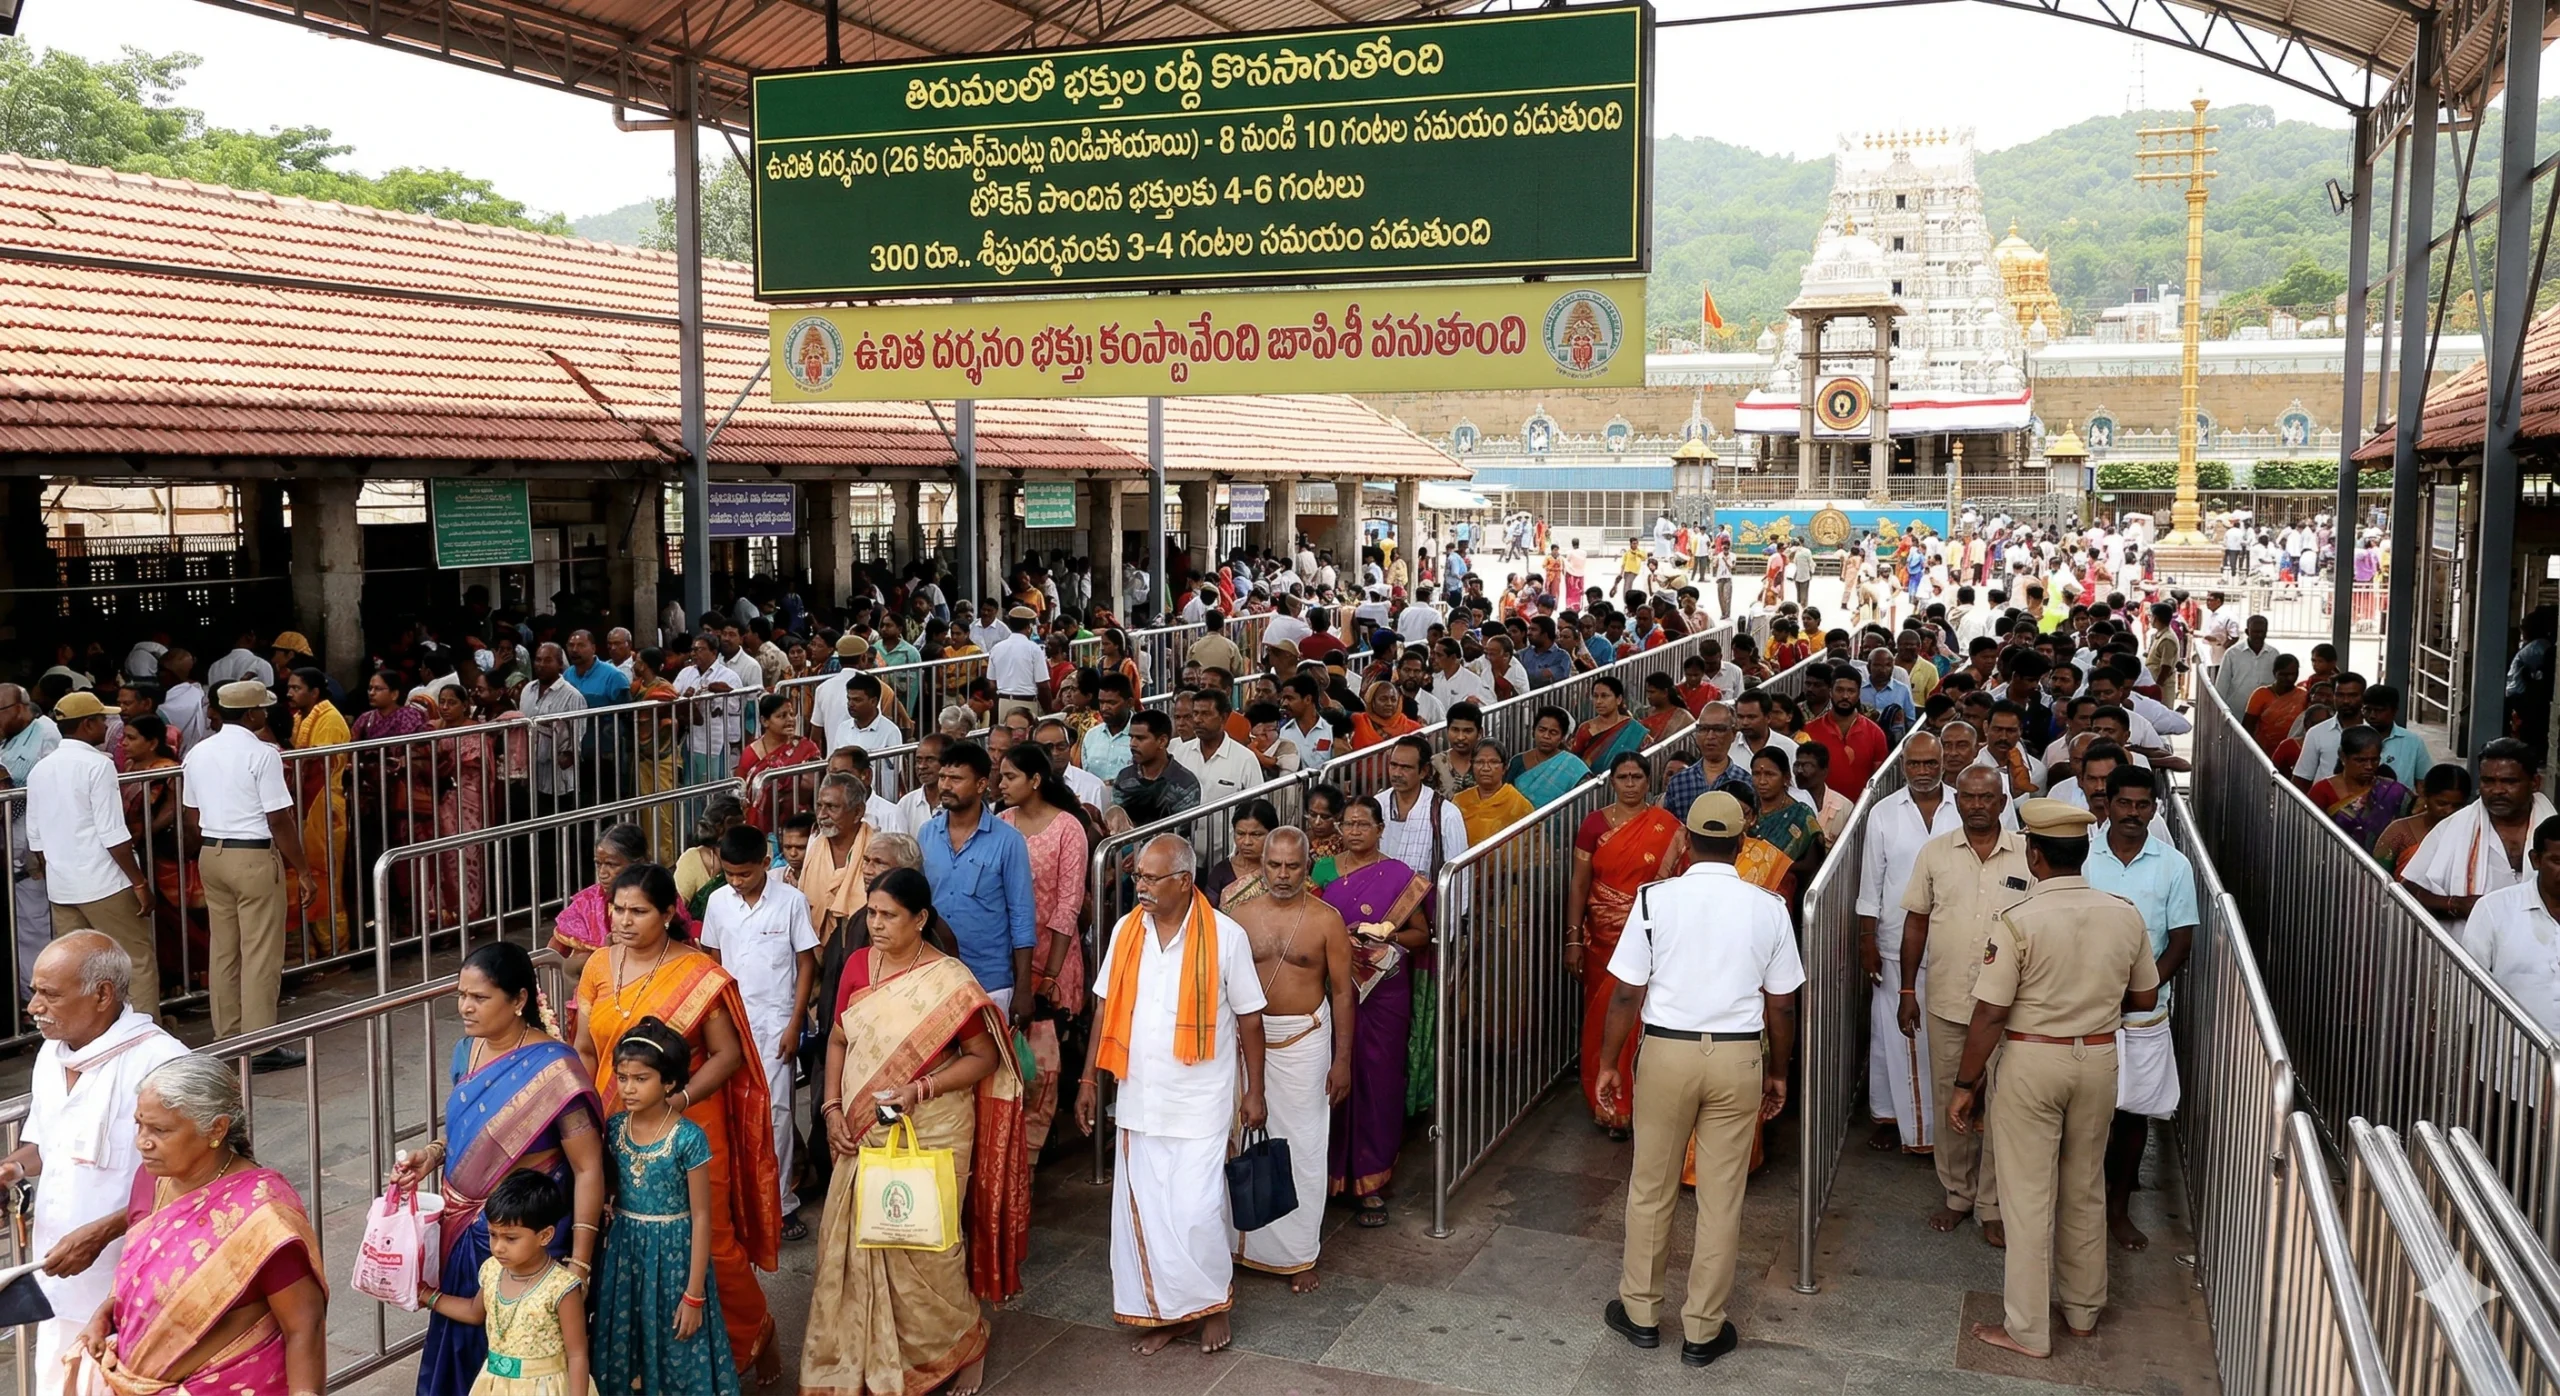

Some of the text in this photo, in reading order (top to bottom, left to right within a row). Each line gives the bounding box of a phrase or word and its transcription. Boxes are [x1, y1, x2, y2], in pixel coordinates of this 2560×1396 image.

[906, 35, 1444, 110] తిరుమలలో భక్తుల రద్దీ కొనసాగుతోంది
[765, 149, 814, 180] ఉచిత
[817, 147, 878, 188] దర్శనం
[882, 145, 919, 178] (26
[1049, 126, 1198, 164] నిండిపోయాయి)
[1204, 138, 1214, 146] -
[1219, 125, 1235, 154] 8
[1241, 113, 1297, 152] నుండి
[1304, 119, 1336, 149] 10
[1340, 112, 1408, 146] గంటల
[1413, 107, 1507, 142] సమయం
[1513, 101, 1623, 136] పడుతుంది
[969, 169, 1365, 220] టోకెన్ పొందిన భక్తులకు 4-6 గంటలు
[870, 216, 1491, 277] 300 రూ.. శీఘ్రదర్శనంకు 3-4 గంటల సమయం పడుతుంది
[853, 330, 926, 370] ఉచిత
